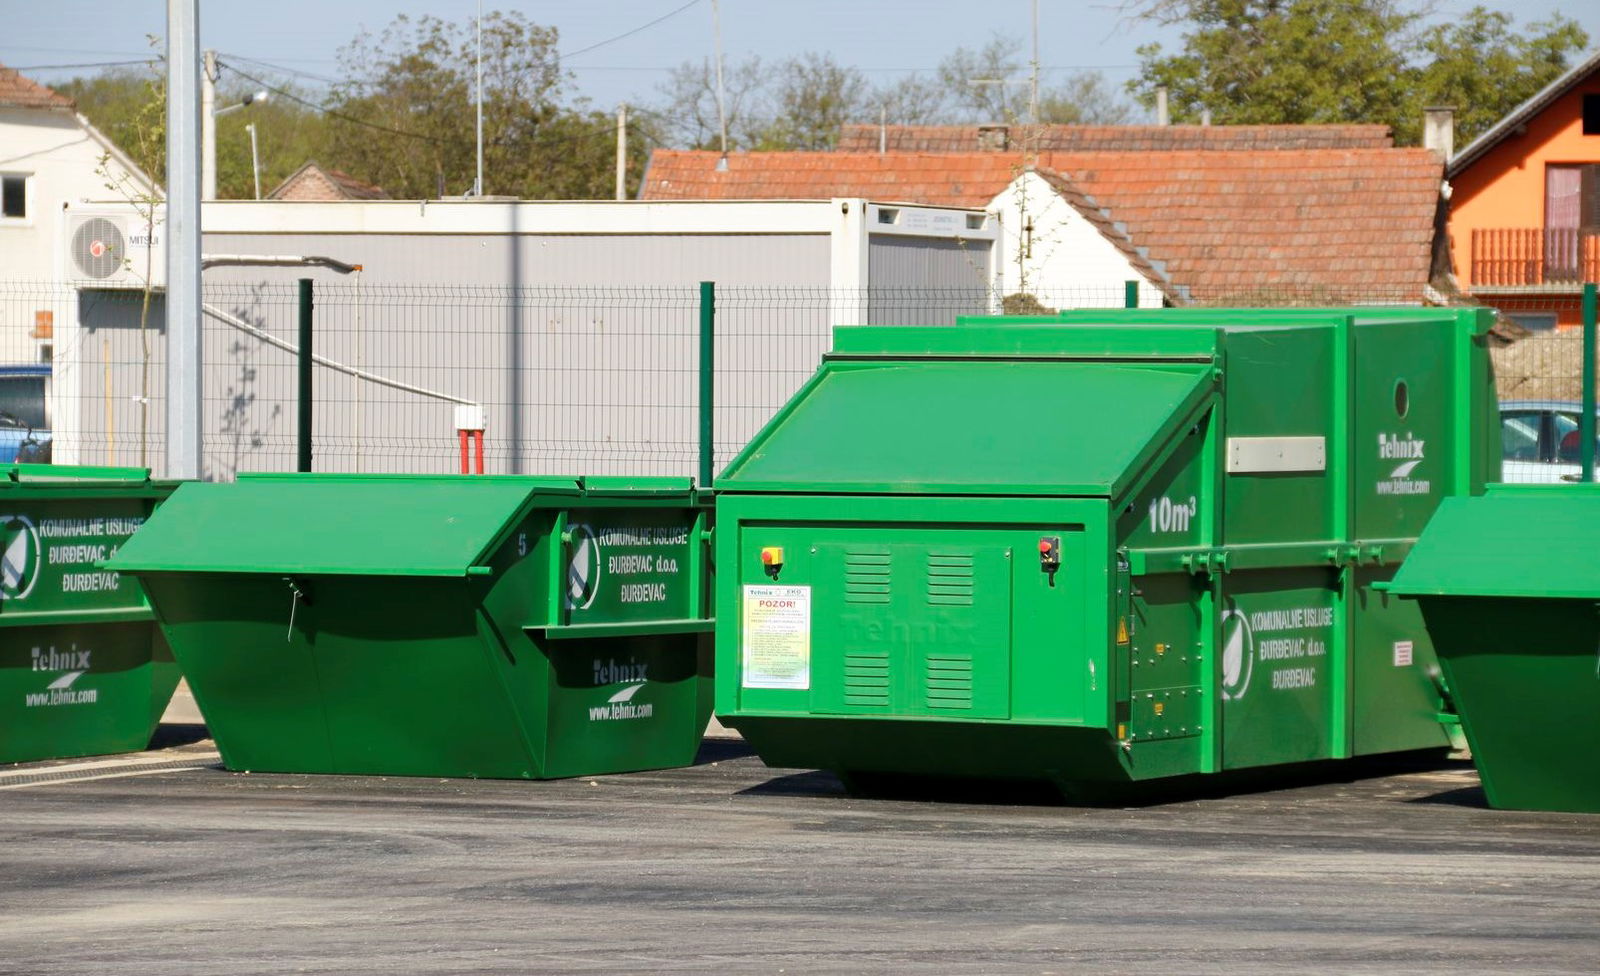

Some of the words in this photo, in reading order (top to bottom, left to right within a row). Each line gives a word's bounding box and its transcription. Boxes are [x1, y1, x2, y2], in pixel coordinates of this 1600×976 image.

[1378, 431, 1425, 459] Tehnix
[1377, 477, 1430, 495] www.tehnix.com
[40, 518, 103, 538] KOMUNALNE
[599, 527, 651, 546] KOMUNALNE
[653, 526, 688, 545] USLUGE
[49, 544, 106, 565] ĐURĐEVAC
[608, 556, 653, 574] ĐURĐEVAC
[656, 557, 678, 574] d.o.o.
[63, 572, 119, 592] ĐURĐEVAC
[621, 583, 666, 603] ĐURĐEVAC
[759, 600, 796, 609] POZOR!
[1251, 610, 1303, 632] KOMUNALNE
[1304, 607, 1333, 628] USLUGE
[31, 643, 91, 671] Tehnix
[1260, 638, 1305, 661] ĐURĐEVAC
[1308, 636, 1326, 656] d.o.o.
[593, 656, 648, 685] Tehnix
[1272, 668, 1316, 690] ĐURĐEVAC
[26, 688, 97, 707] www.tehnix.com
[589, 701, 653, 721] www.tehnix.com
